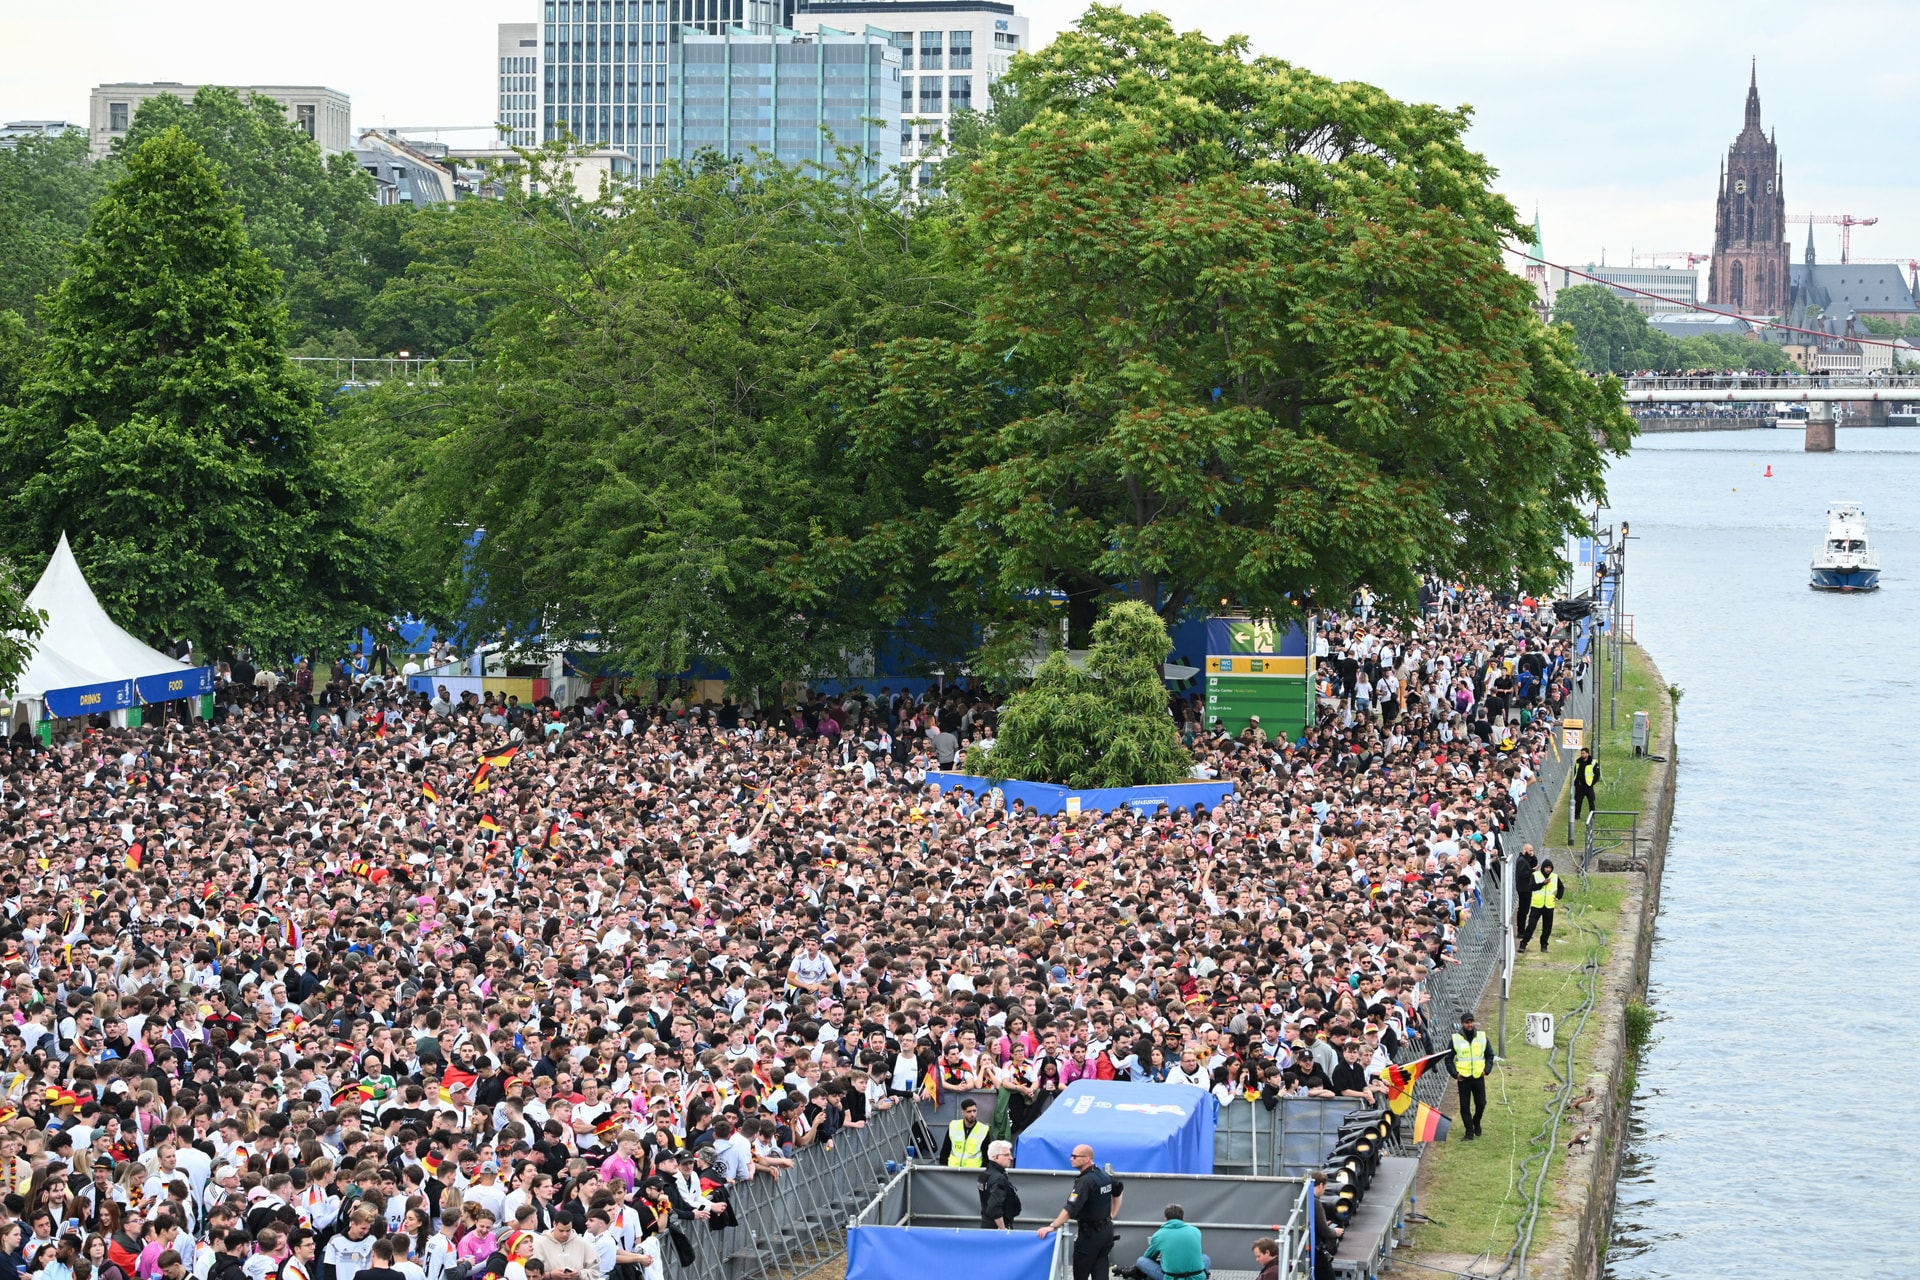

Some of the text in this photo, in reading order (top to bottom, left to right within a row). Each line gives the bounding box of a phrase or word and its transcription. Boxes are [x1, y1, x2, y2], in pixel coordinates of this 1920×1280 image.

[168, 679, 183, 692] FOOD
[79, 692, 101, 706] DRINKS
[1542, 1016, 1550, 1033] 0
[1100, 1183, 1113, 1195] POLIZE
[391, 1214, 402, 1223] 24
